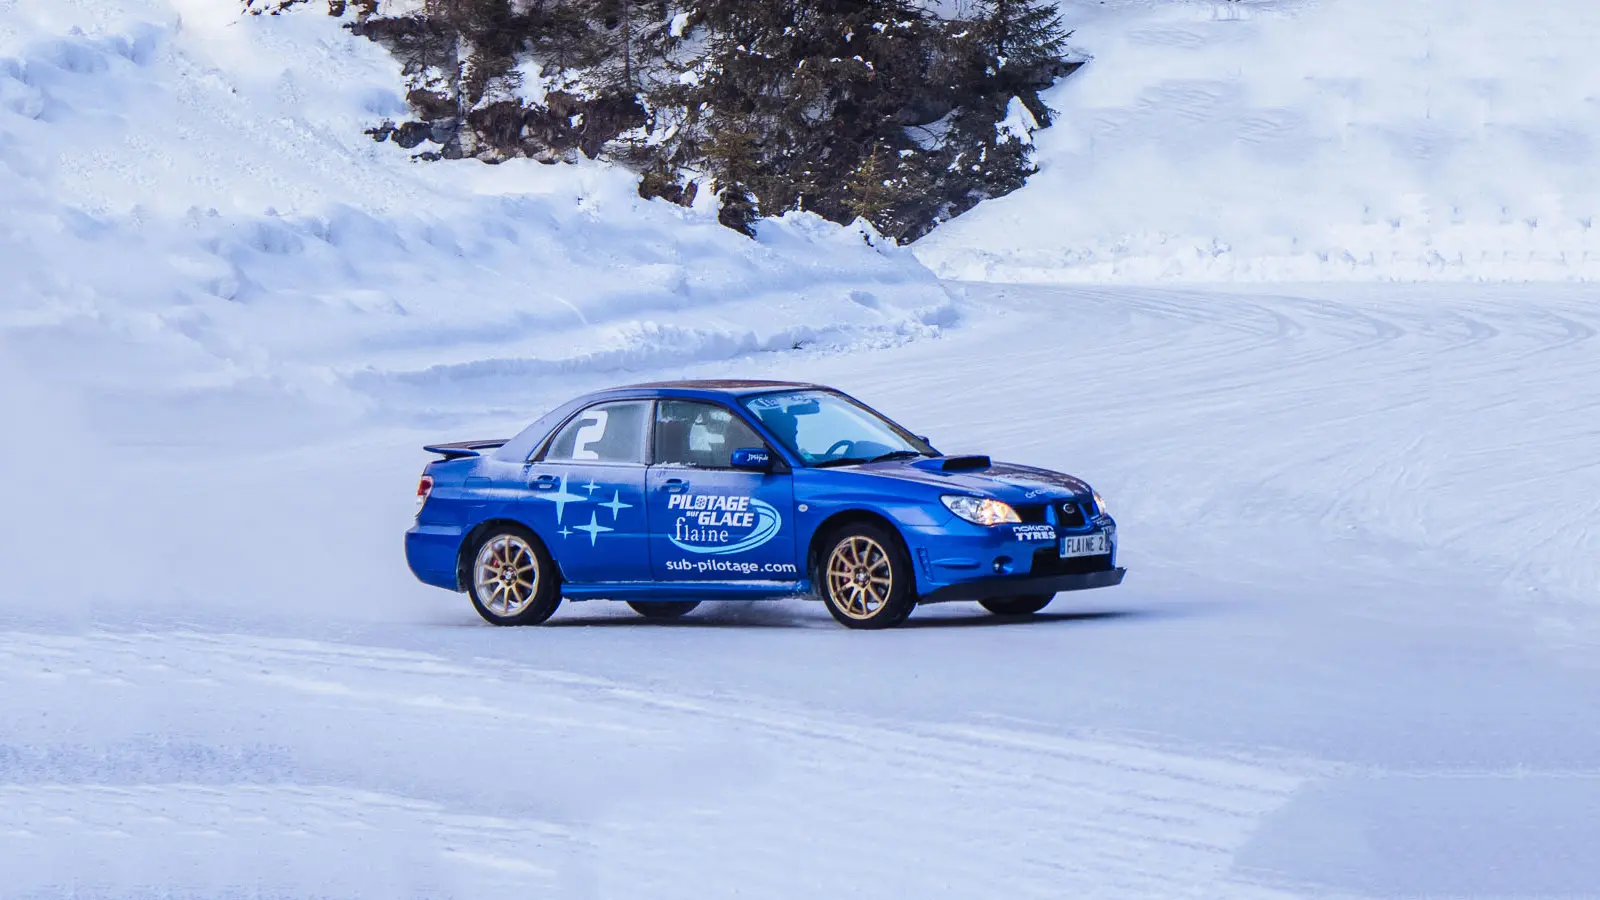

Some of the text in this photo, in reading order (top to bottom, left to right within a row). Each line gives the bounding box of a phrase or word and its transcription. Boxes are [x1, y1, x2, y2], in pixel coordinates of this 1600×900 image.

[572, 410, 608, 460] 2
[668, 495, 750, 511] PILOTAGE
[698, 512, 754, 527] GLACE
[675, 517, 728, 542] flaine
[1016, 532, 1056, 541] TYRES
[1067, 537, 1104, 553] FLAINE 2
[666, 559, 797, 573] sub-pilotage.com
